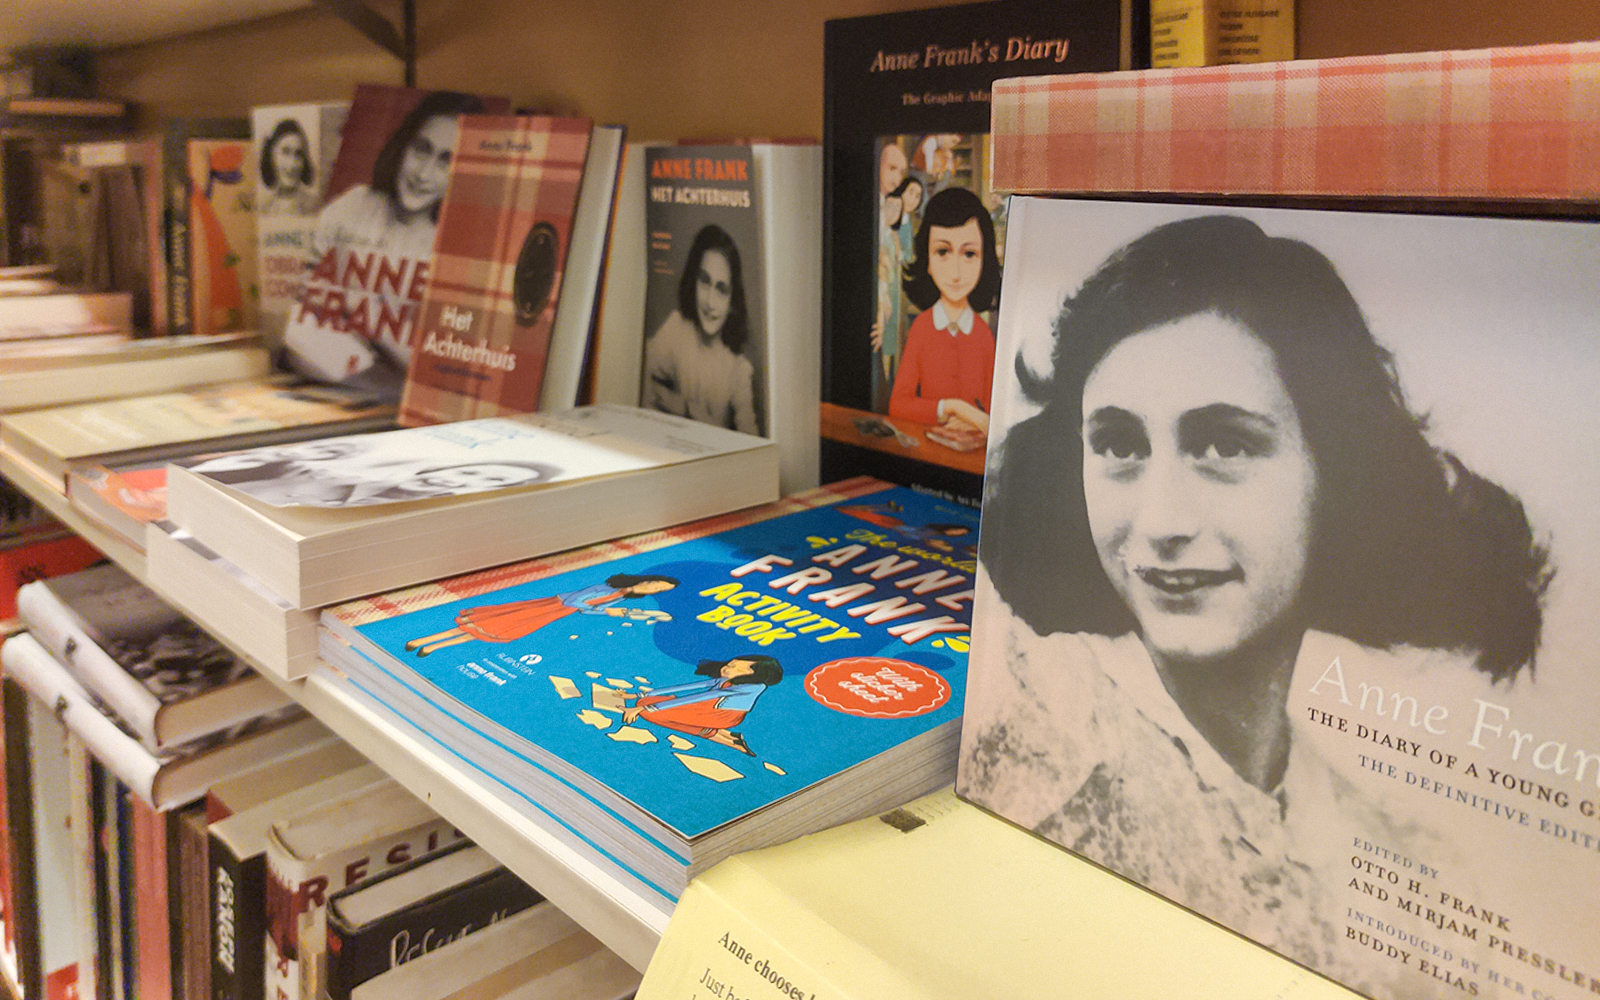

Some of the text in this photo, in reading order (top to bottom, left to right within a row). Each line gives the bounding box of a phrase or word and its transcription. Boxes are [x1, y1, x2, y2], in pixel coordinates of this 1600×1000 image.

[869, 34, 1070, 73] Anne Frank's Diary
[902, 92, 921, 106] The
[650, 186, 751, 208] HET ACHTERHUIS
[651, 158, 748, 181] ANNE FRANK
[310, 246, 430, 301] ANNE
[299, 287, 419, 348] FRAN
[442, 305, 475, 333] Het
[422, 330, 518, 372] Achterhuis
[695, 604, 798, 647] BOOK
[699, 581, 862, 644] ACTIVITY
[729, 553, 972, 647] FRANK
[1308, 655, 1450, 736] Anne
[1307, 706, 1600, 821] THE DIARY OF A YOUNG G
[1358, 753, 1398, 780] THE
[1404, 770, 1531, 828] DEFINITIVE
[1352, 837, 1440, 880] EDITED BY
[1347, 876, 1390, 903] AND
[1396, 895, 1478, 942] MIRJAM
[1350, 855, 1512, 933] OTTO H. FRANK
[717, 931, 805, 1000] Anne chooses
[1344, 925, 1480, 997] BUDDY ELIAS
[1346, 906, 1454, 962] INTRODUCED
[1460, 957, 1482, 975] BY
[1488, 968, 1525, 996] HER
[699, 967, 726, 999] Just
